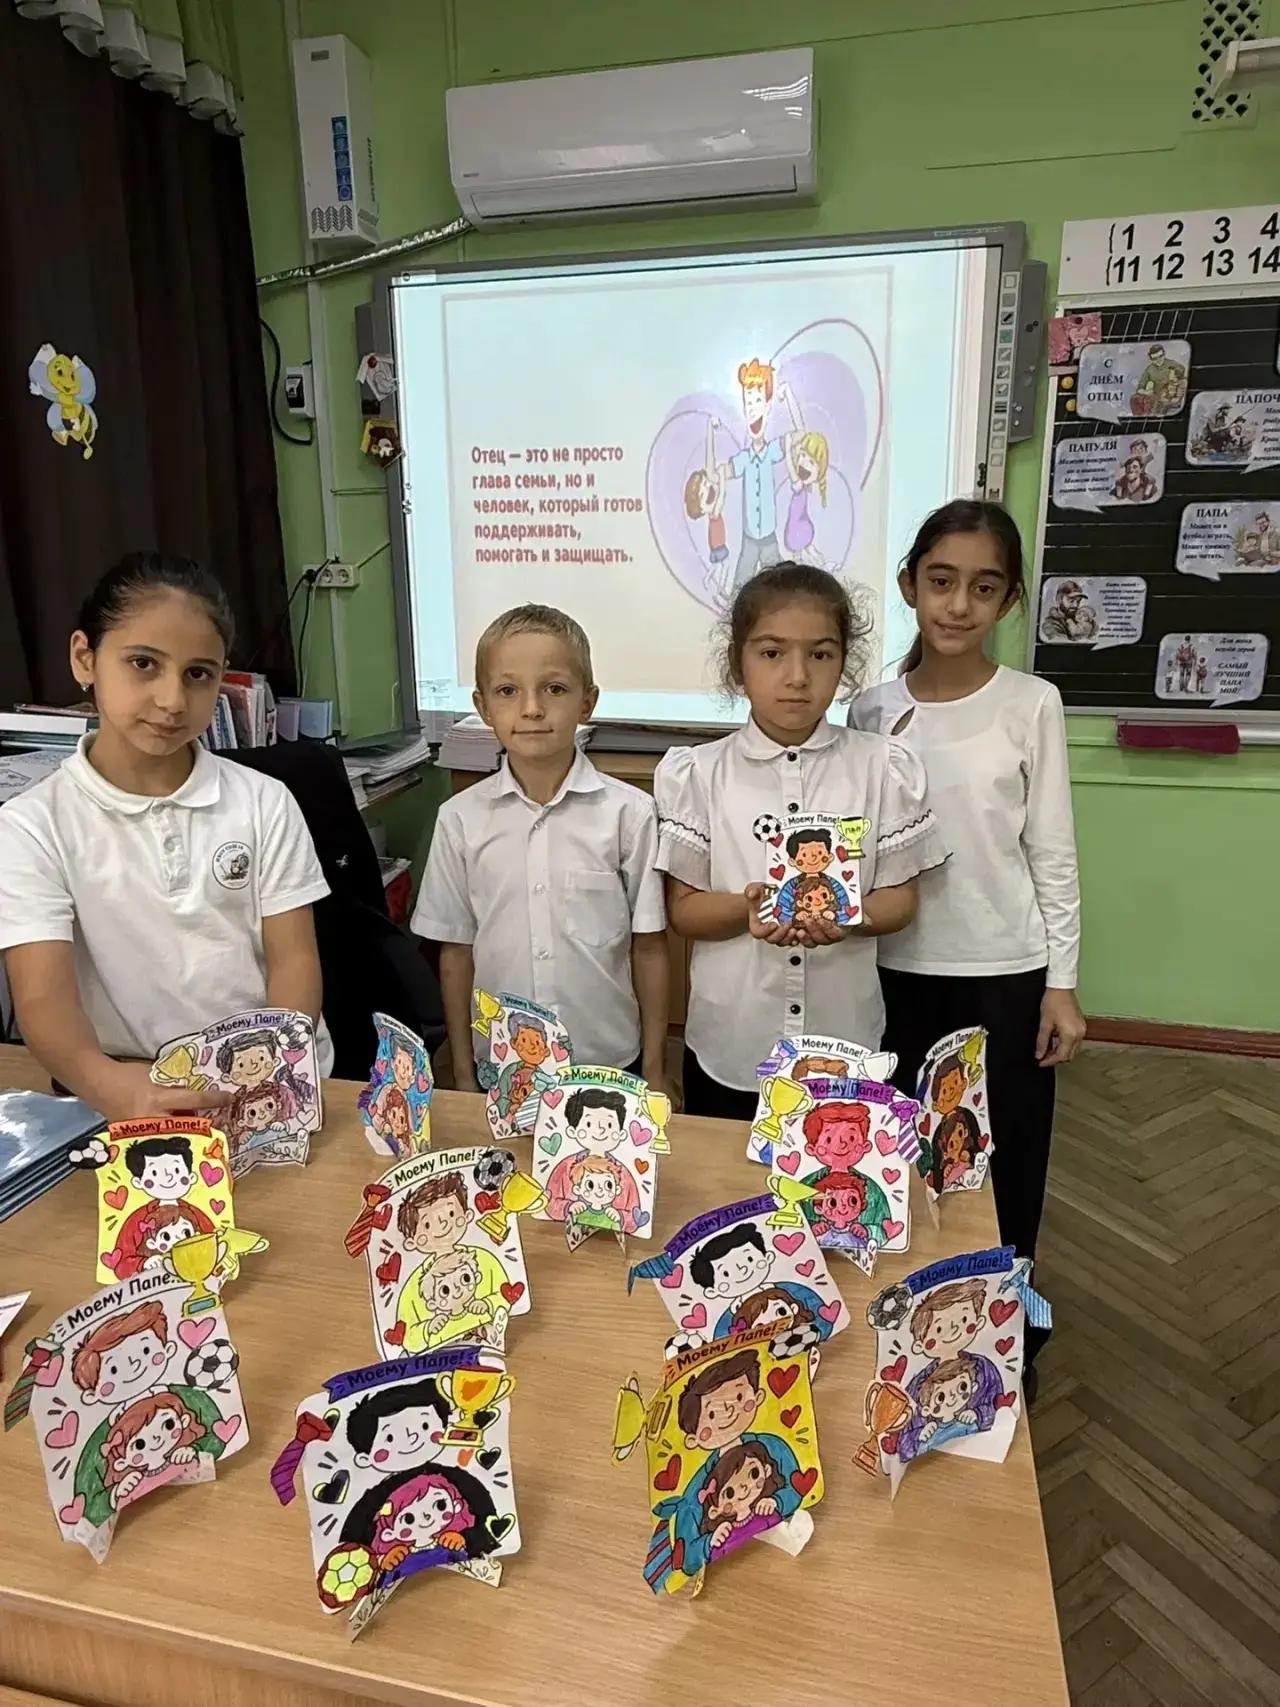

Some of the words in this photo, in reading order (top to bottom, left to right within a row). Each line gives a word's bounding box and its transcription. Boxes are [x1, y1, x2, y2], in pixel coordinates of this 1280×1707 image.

[1164, 220, 1184, 248] 2
[1212, 216, 1231, 244] 3
[1260, 212, 1280, 240] 4
[1152, 253, 1184, 280] 12
[1202, 249, 1234, 277] 13
[1248, 246, 1280, 274] 14
[1104, 358, 1113, 369] С
[1089, 373, 1124, 386] ДНЁМ
[1087, 391, 1123, 402] ОТЦА!
[471, 446, 506, 465] Отец
[525, 449, 549, 462] это
[552, 447, 570, 462] не
[573, 446, 624, 465] просто
[1069, 441, 1117, 452] ПАПУЛЯ
[472, 474, 511, 489] глава
[515, 473, 561, 490] семьи,
[565, 473, 582, 488] но
[586, 473, 595, 488] и
[473, 499, 535, 515] человек,
[539, 495, 600, 516] который
[604, 497, 643, 513] готов
[1196, 508, 1228, 517] ПАПА
[474, 522, 582, 541] поддерживать,
[475, 548, 538, 563] помогать
[542, 548, 549, 562] и
[554, 548, 634, 565] защищать.
[788, 815, 815, 825] Моему
[215, 1018, 251, 1035] Моему
[254, 1013, 285, 1027] Папе!
[801, 1038, 834, 1052] Моему
[836, 1042, 864, 1058] Папе!
[571, 1069, 607, 1083] Моему
[609, 1072, 637, 1089] Папе!
[807, 1084, 847, 1096] Моему
[851, 1082, 884, 1095] Папе!
[120, 1121, 161, 1135] Моему
[165, 1119, 201, 1130] Папе!
[394, 1159, 435, 1187] Моему
[439, 1148, 476, 1167] Папе!
[680, 1215, 721, 1246] Моему
[723, 1200, 763, 1221] Папе!
[919, 1262, 964, 1287] Моему
[967, 1252, 1003, 1270] Папе!
[67, 1288, 124, 1330] Моему
[129, 1272, 175, 1296] Папе
[676, 1340, 730, 1370] Моему
[734, 1323, 777, 1345] Папе!
[346, 1361, 408, 1388] Моему
[414, 1351, 465, 1370] Папе!
